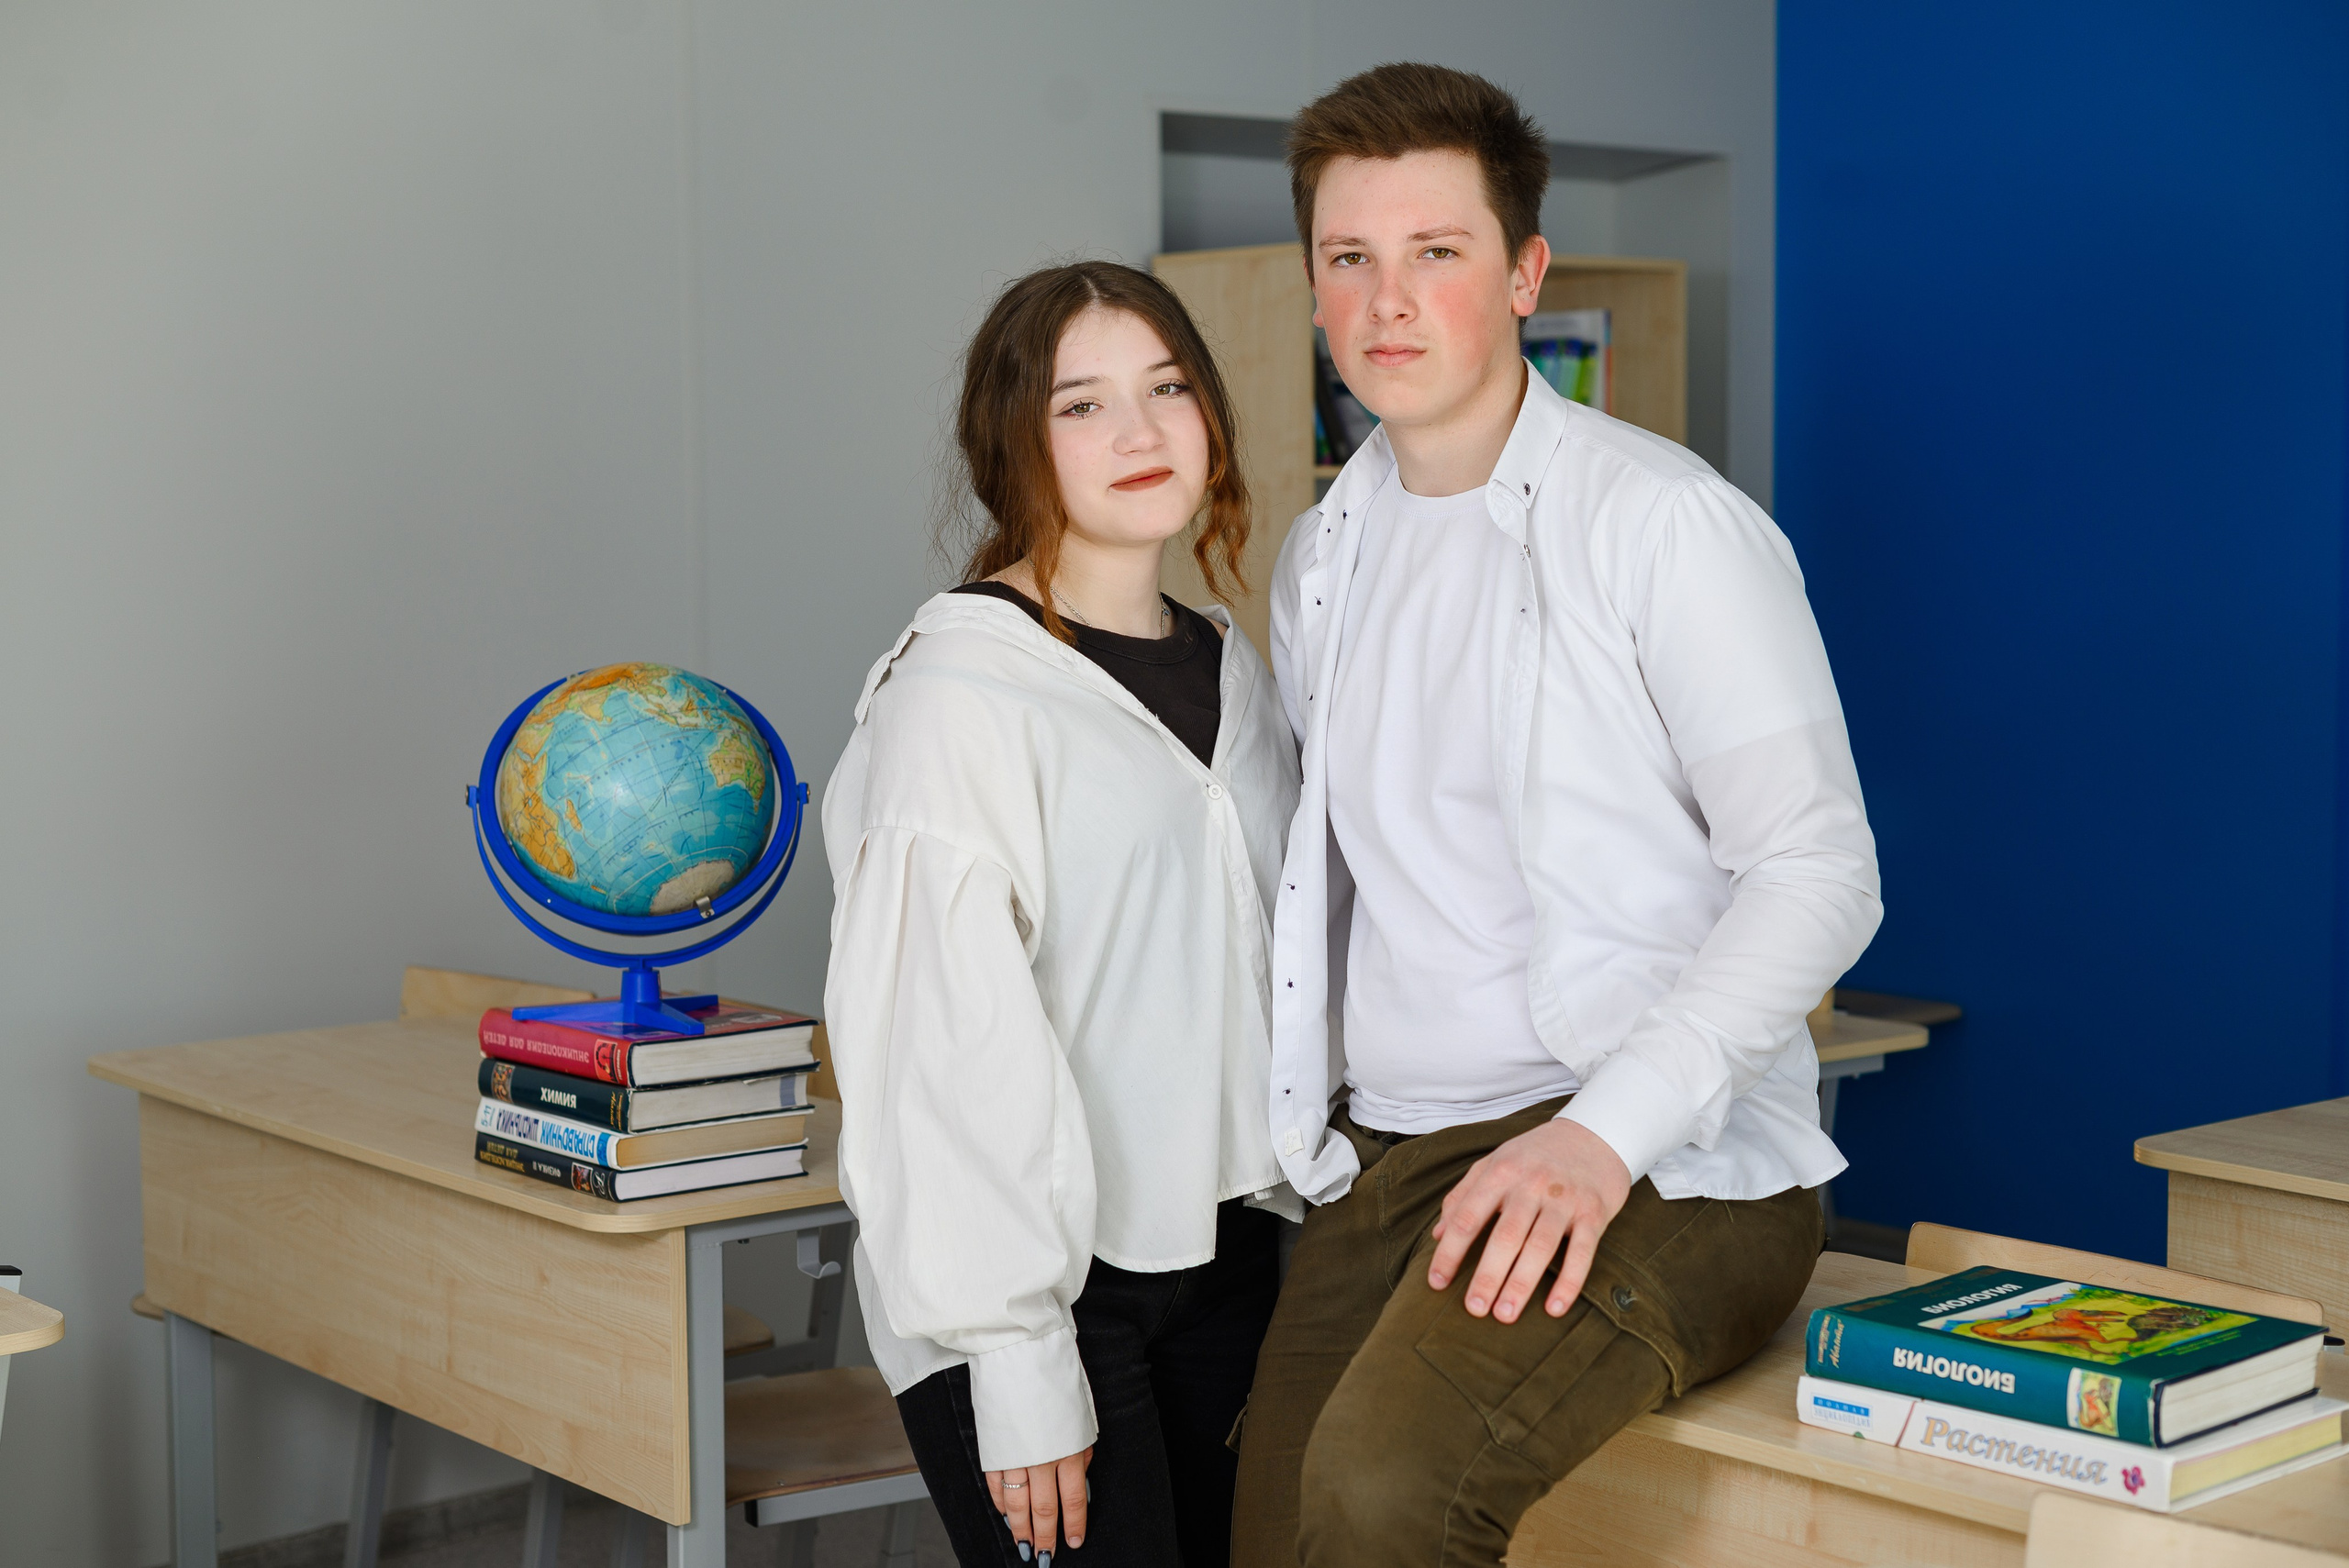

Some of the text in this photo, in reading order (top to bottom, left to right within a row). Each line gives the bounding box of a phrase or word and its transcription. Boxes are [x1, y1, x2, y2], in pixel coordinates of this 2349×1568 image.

[484, 1030, 589, 1063] ЭНЦИКЛОПЕДИЯ ДЛЯ ДЕТЕЙ
[540, 1087, 576, 1108] ХИМИЯ
[496, 1108, 539, 1141] ШКОЛЬНИКА
[540, 1121, 596, 1158] СПРАВОЧНИК
[1920, 1282, 2023, 1315] БИОЛОГИЯ
[1892, 1345, 2017, 1395] БИОЛОГИЯ
[1920, 1415, 2109, 1485] Растения
